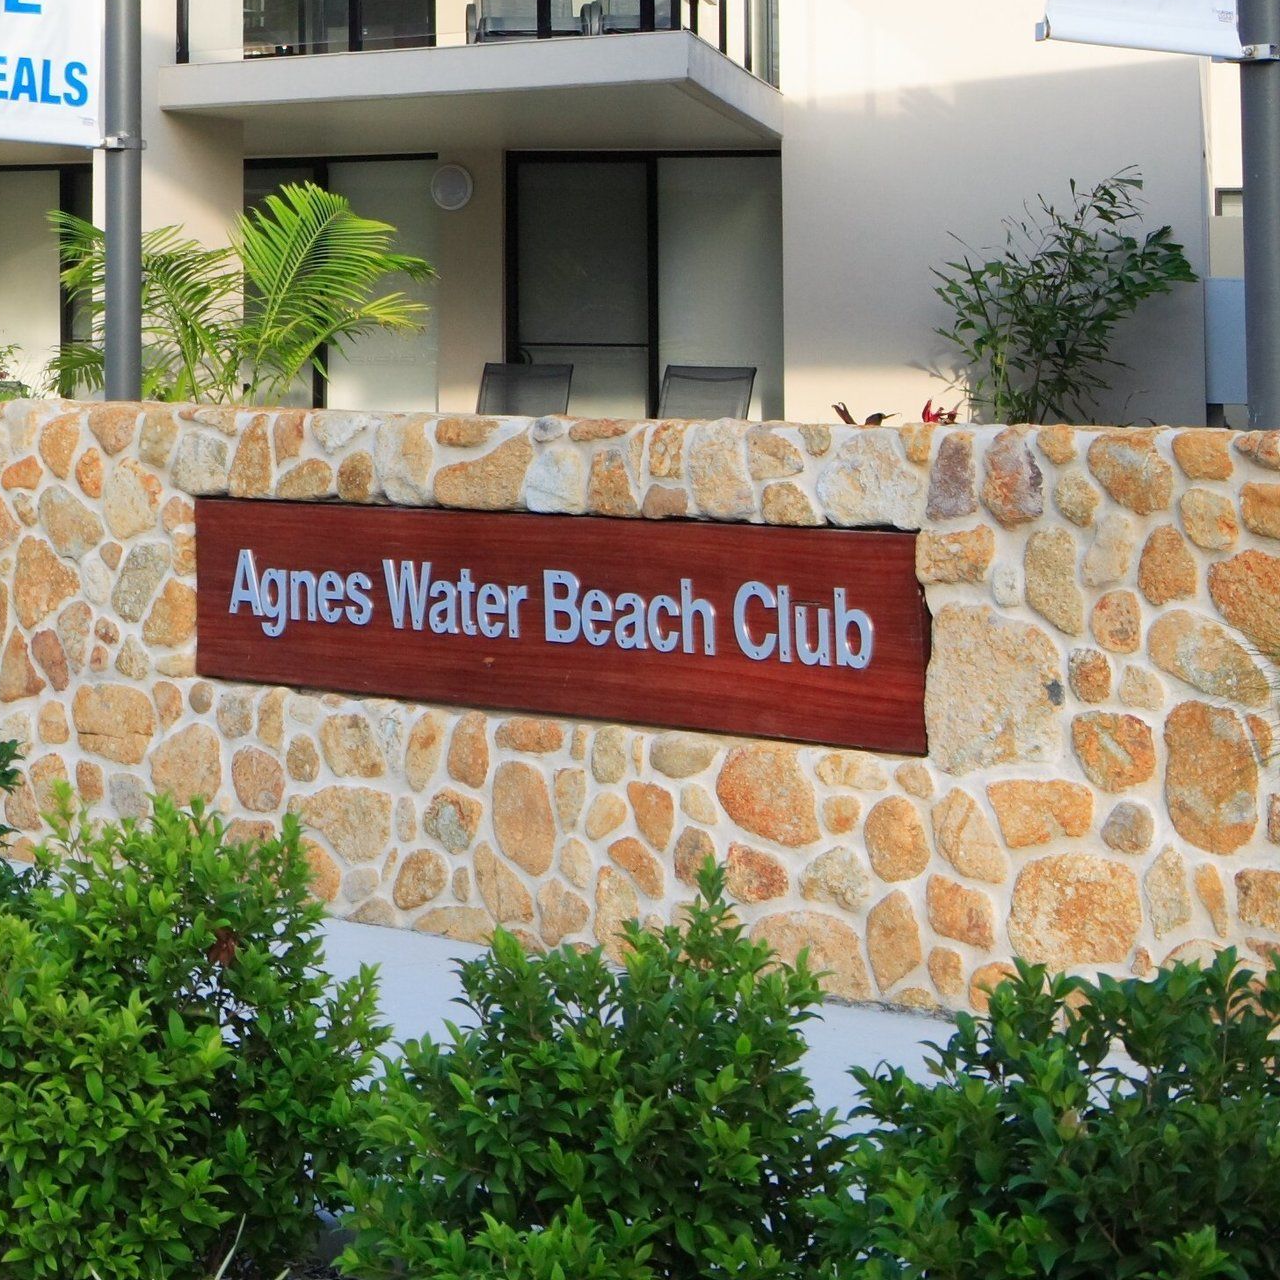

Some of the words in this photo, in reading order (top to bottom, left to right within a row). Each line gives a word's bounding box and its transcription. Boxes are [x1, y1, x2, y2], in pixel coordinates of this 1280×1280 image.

[228, 547, 375, 638] Agnes
[380, 558, 529, 640] Water
[542, 568, 718, 657] Beach
[732, 579, 877, 671] Club
